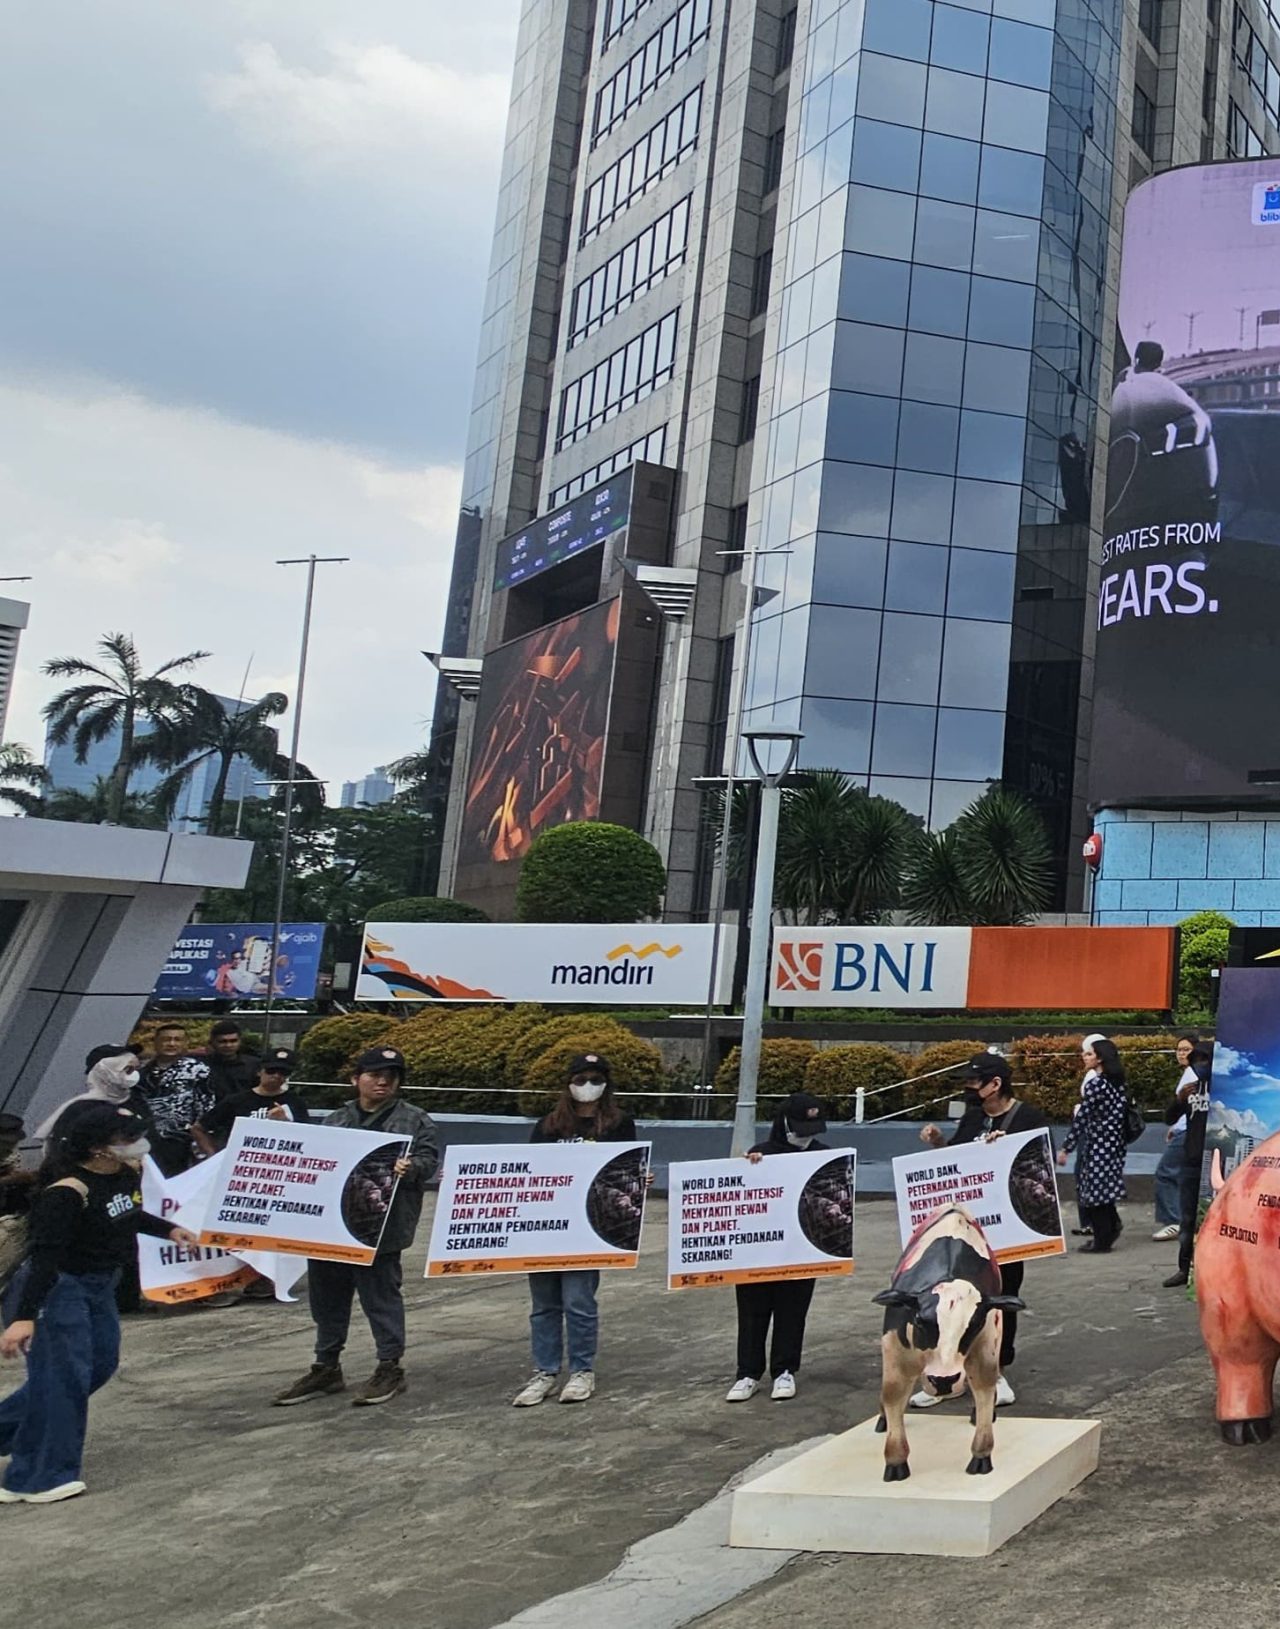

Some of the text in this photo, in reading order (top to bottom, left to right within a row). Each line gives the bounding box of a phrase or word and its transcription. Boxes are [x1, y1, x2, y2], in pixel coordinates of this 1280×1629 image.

[1116, 525, 1160, 556] RATES
[1164, 522, 1221, 545] FROM
[551, 959, 654, 985] mandiri
[831, 943, 938, 994] BNI
[243, 1136, 304, 1154] WORLD BANK,
[237, 1151, 338, 1171] PETERNAKAN INTENSIF
[459, 1162, 532, 1175] WORLD BANK,
[232, 1165, 318, 1185] MENYAKITI HEWAN
[905, 1164, 961, 1183] WORLD BANK,
[227, 1180, 286, 1197] DAN PLANET.
[455, 1175, 574, 1190] PETERNAKAN INTENSIF
[681, 1176, 746, 1190] WORLD BANK,
[907, 1171, 995, 1198] PETERNAKAN INTENSIF
[453, 1190, 554, 1205] MENYAKITI HEWAN
[682, 1187, 785, 1205] PETERNAKAN INTENSIF
[955, 1188, 983, 1203] HEWAN
[106, 1193, 133, 1218] affa
[222, 1195, 324, 1216] HENTIKAN PENDANAAN
[451, 1206, 520, 1220] DAN PLANET.
[682, 1203, 768, 1220] MENYAKITI HEWAN
[218, 1210, 271, 1226] SEKARANG!
[448, 1219, 569, 1235] HENTIKAN PENDANAAN
[682, 1220, 741, 1234] DAN PLANET.
[1219, 1223, 1259, 1245] EKSPLOITASI
[446, 1237, 508, 1250] SEKARANG!
[681, 1230, 784, 1249] HENTIKAN PENDANAAN
[681, 1249, 732, 1263] SEKARANG!
